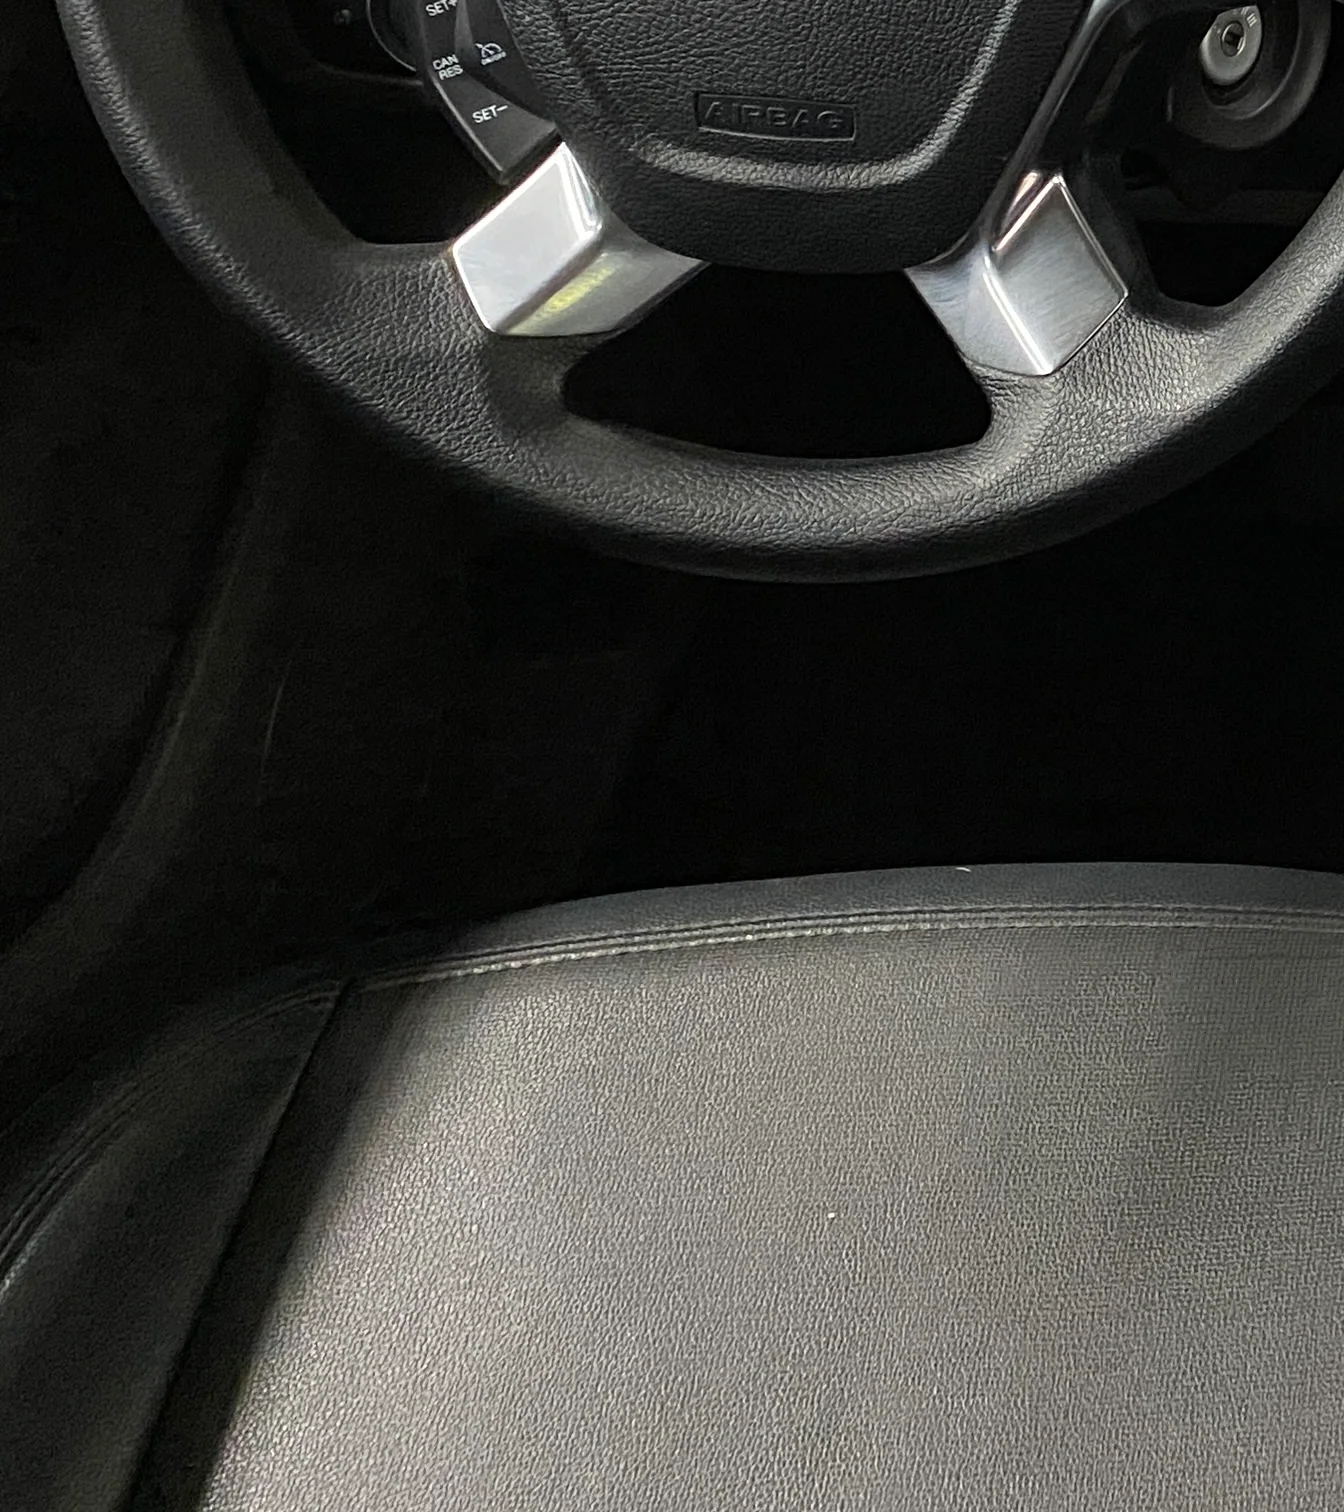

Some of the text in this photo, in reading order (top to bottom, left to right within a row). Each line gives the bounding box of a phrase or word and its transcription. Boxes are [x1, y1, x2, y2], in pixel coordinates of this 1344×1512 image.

[432, 54, 459, 70] CAN
[438, 64, 464, 80] RES
[704, 101, 845, 130] AIRBAG
